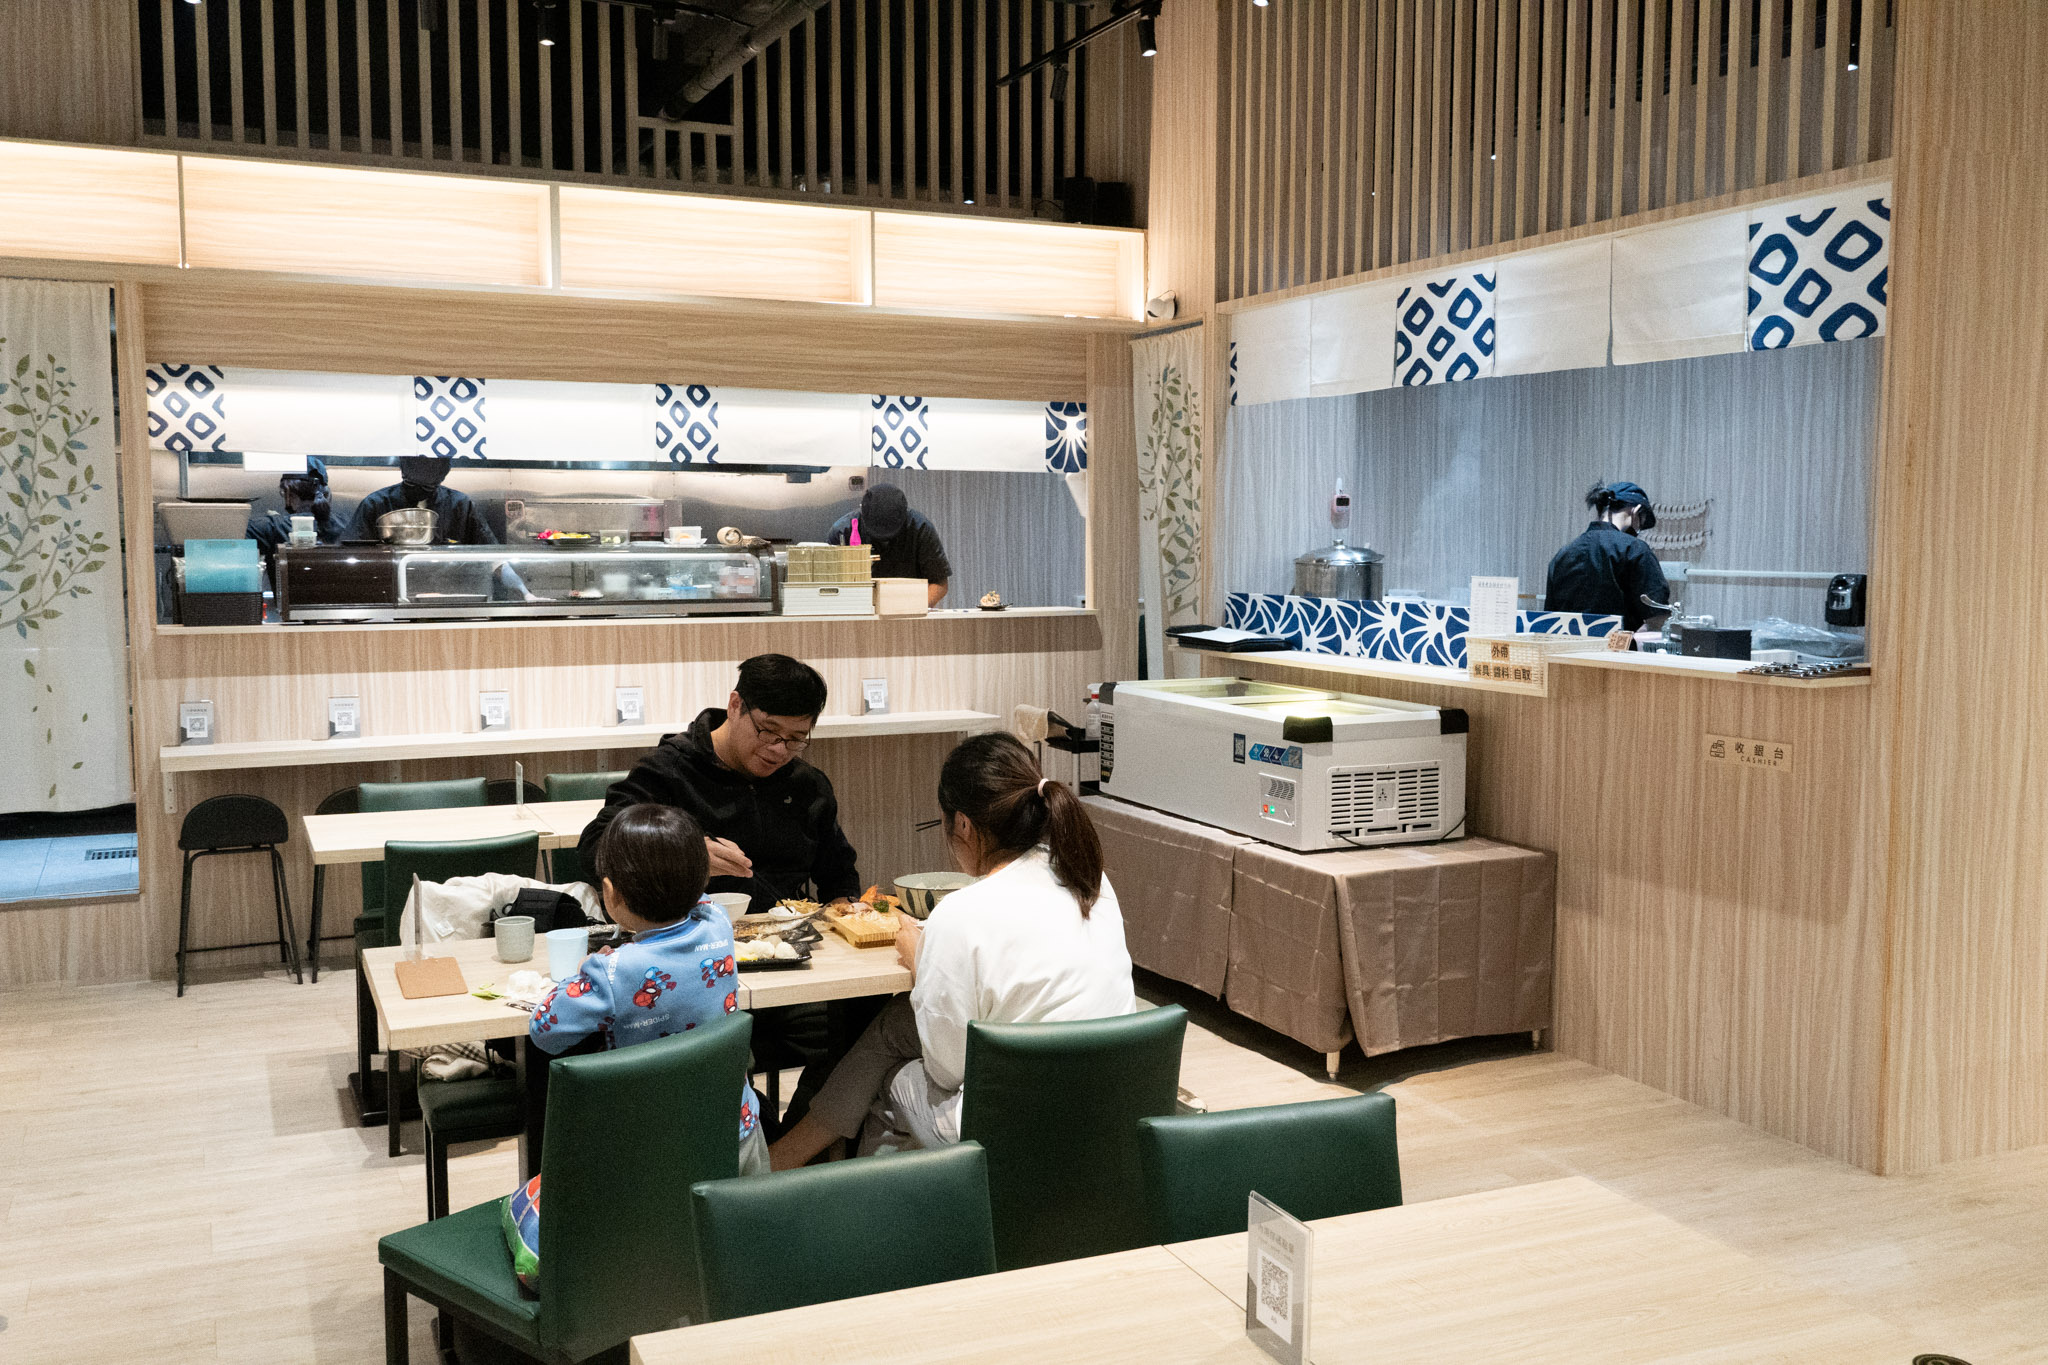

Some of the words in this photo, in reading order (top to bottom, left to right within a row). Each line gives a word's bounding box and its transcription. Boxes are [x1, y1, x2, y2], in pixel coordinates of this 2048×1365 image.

[1492, 643, 1509, 659] 外帶
[1474, 664, 1490, 677] 餐具
[1514, 668, 1531, 681] 自取
[1735, 742, 1784, 760] 收銀台
[1740, 755, 1777, 767] CASHIER
